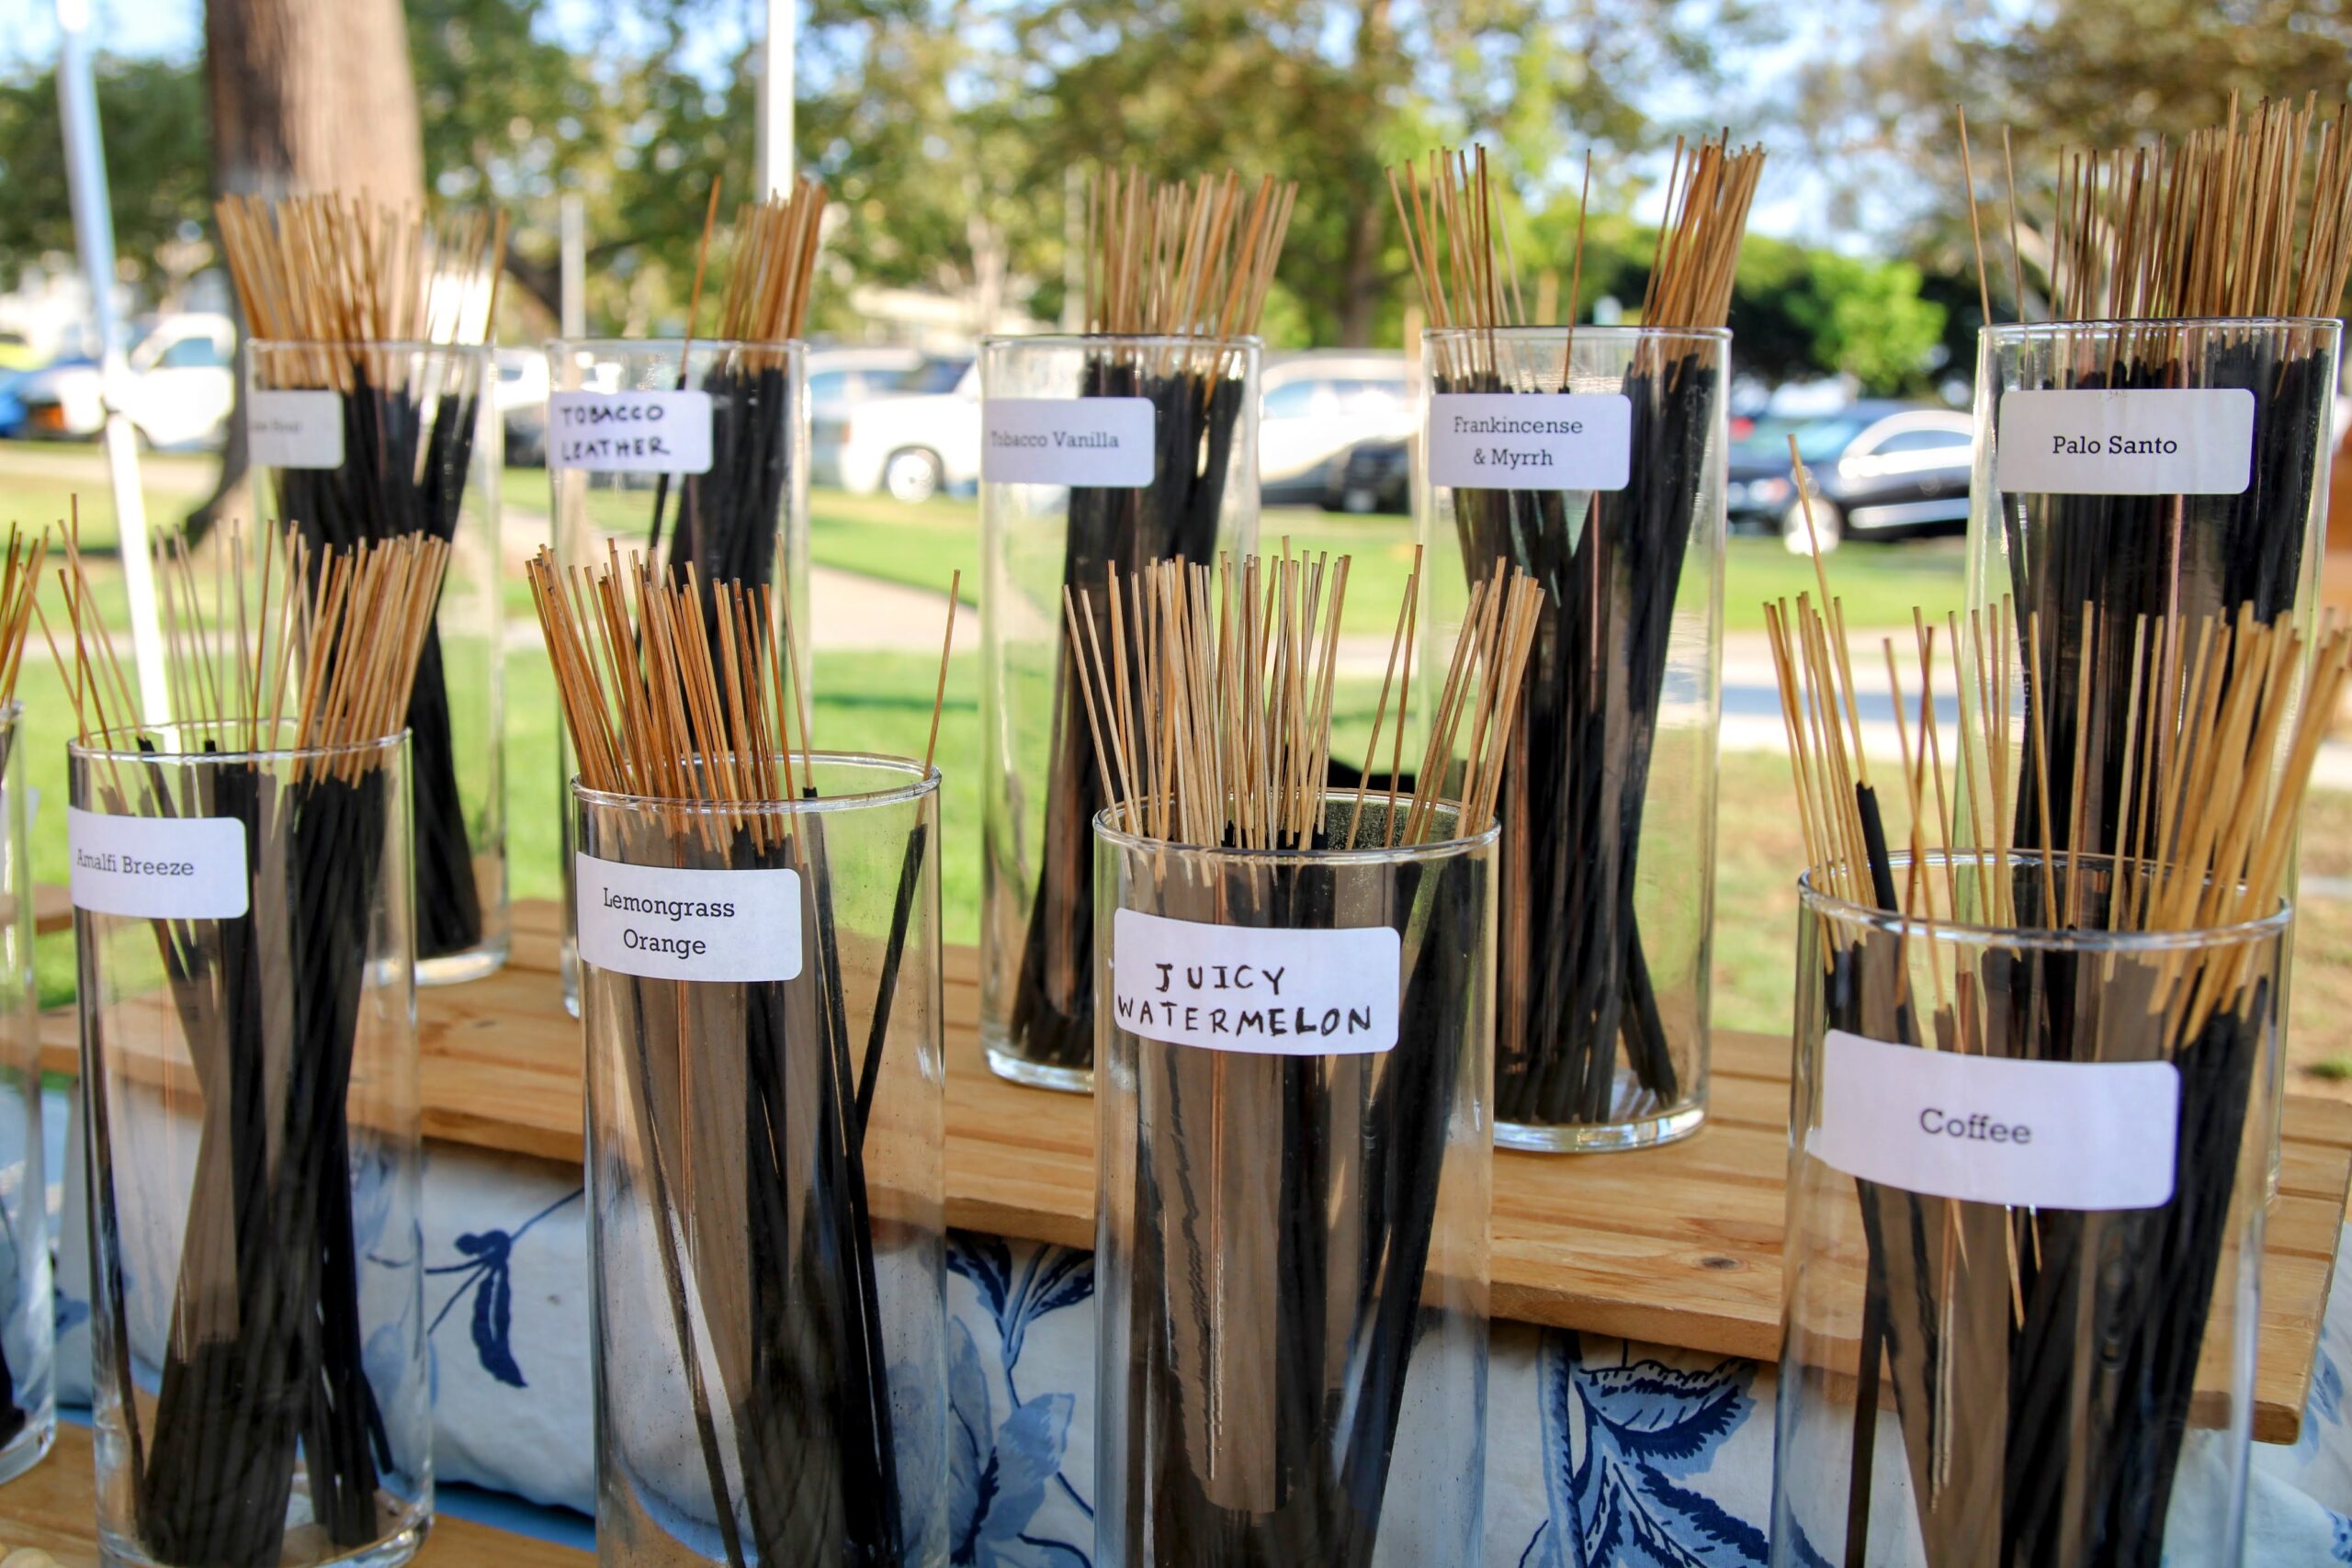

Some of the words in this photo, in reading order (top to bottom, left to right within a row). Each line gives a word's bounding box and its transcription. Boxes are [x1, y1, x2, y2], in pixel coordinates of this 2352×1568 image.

[560, 404, 664, 427] TOBACCO
[1453, 415, 1584, 434] Frankincense
[560, 436, 671, 461] LEATHER
[990, 431, 1048, 448] Tobacco
[1052, 431, 1120, 448] Vanilla
[2052, 435, 2101, 455] Palo
[2108, 435, 2177, 455] Santo
[1473, 447, 1486, 466] &
[1491, 448, 1554, 470] Myrrh
[77, 848, 118, 874] Amalfi
[122, 855, 195, 876] Breeze
[603, 887, 736, 921] Lemongrass
[623, 928, 707, 960] Orange
[1155, 963, 1285, 995] JUICY
[1117, 994, 1372, 1037] WATERMELON
[1919, 1108, 2032, 1145] Coffee
